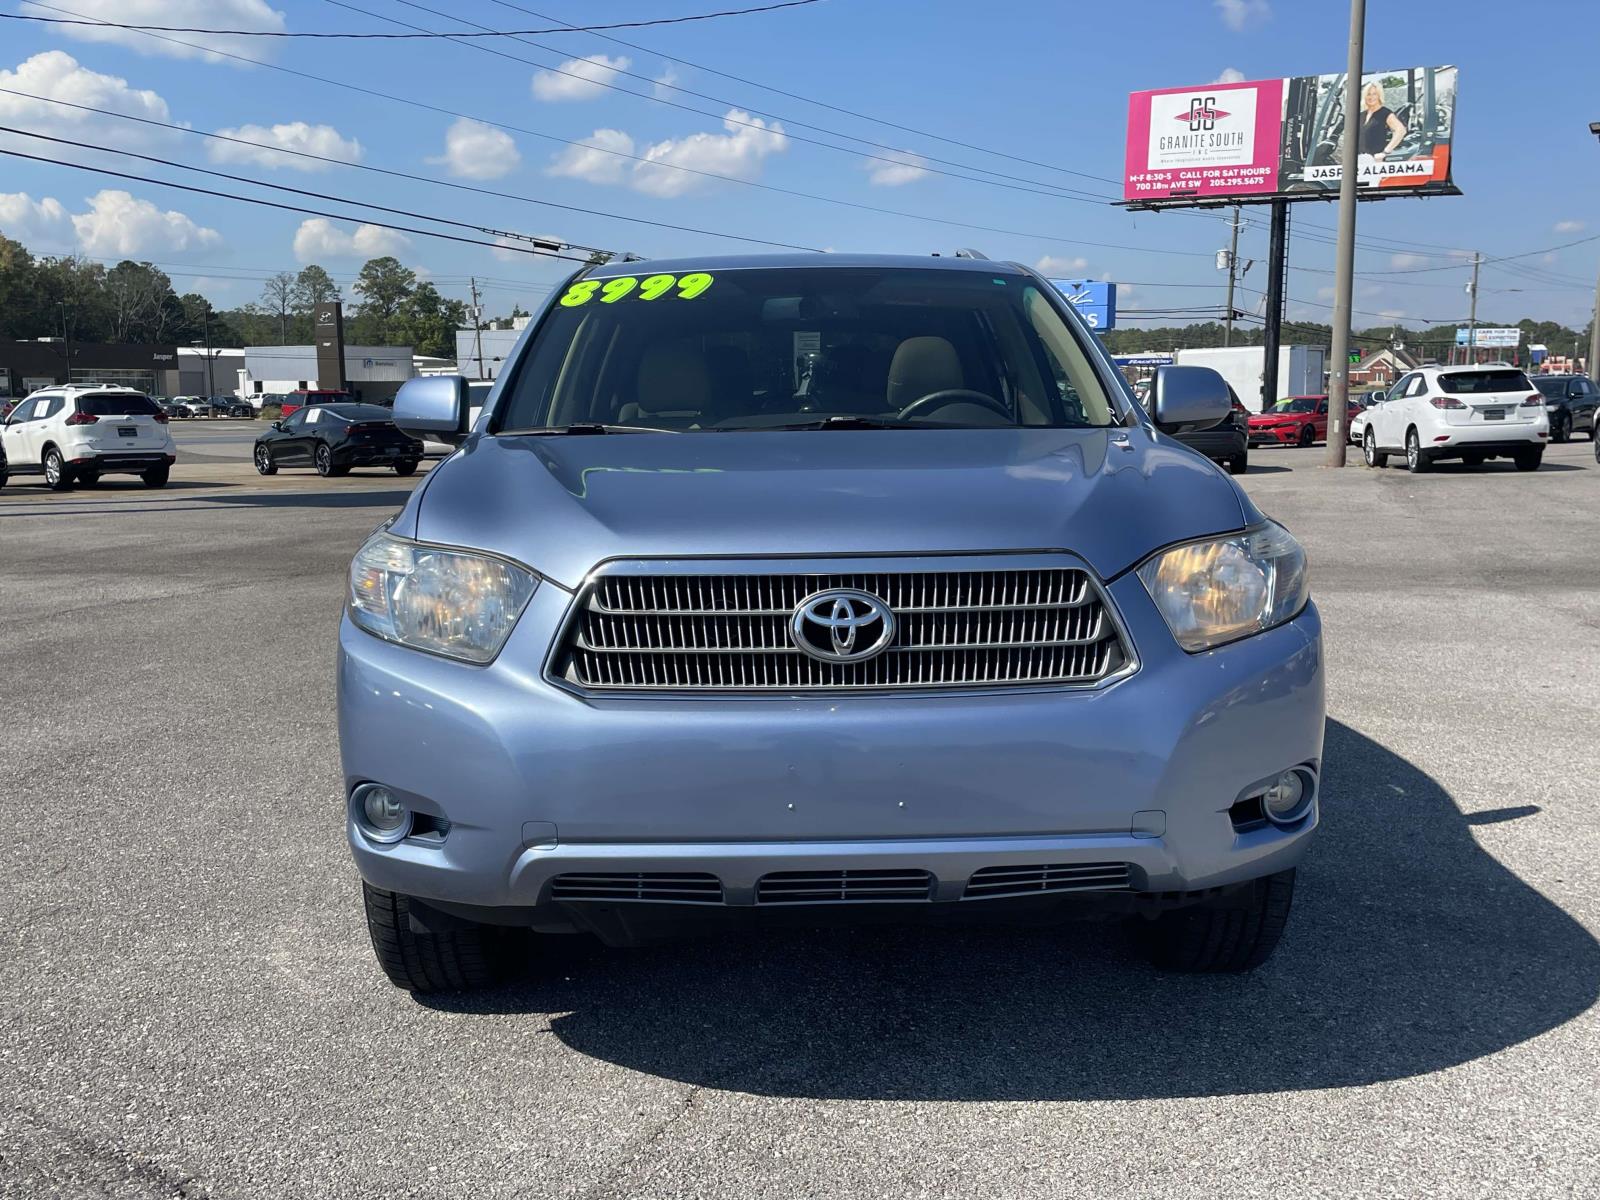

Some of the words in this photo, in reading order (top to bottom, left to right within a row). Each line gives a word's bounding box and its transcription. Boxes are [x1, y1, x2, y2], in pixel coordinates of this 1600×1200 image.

[1160, 133, 1206, 150] GRANITE
[1209, 131, 1244, 146] SOUTH
[1130, 174, 1145, 182] M-F
[1146, 172, 1172, 181] 8:30-5
[1180, 171, 1201, 179] CALL
[1203, 170, 1220, 178] FOR
[1222, 169, 1239, 177] SAT
[1240, 167, 1271, 176] HOURS
[1312, 168, 1359, 178] JASP
[1363, 163, 1424, 176] ALABAMA
[1136, 182, 1151, 190] 700
[1170, 181, 1186, 189] AVE
[1188, 180, 1202, 188] SW
[1210, 176, 1264, 187] 205.295.5675
[560, 273, 713, 307] 8999
